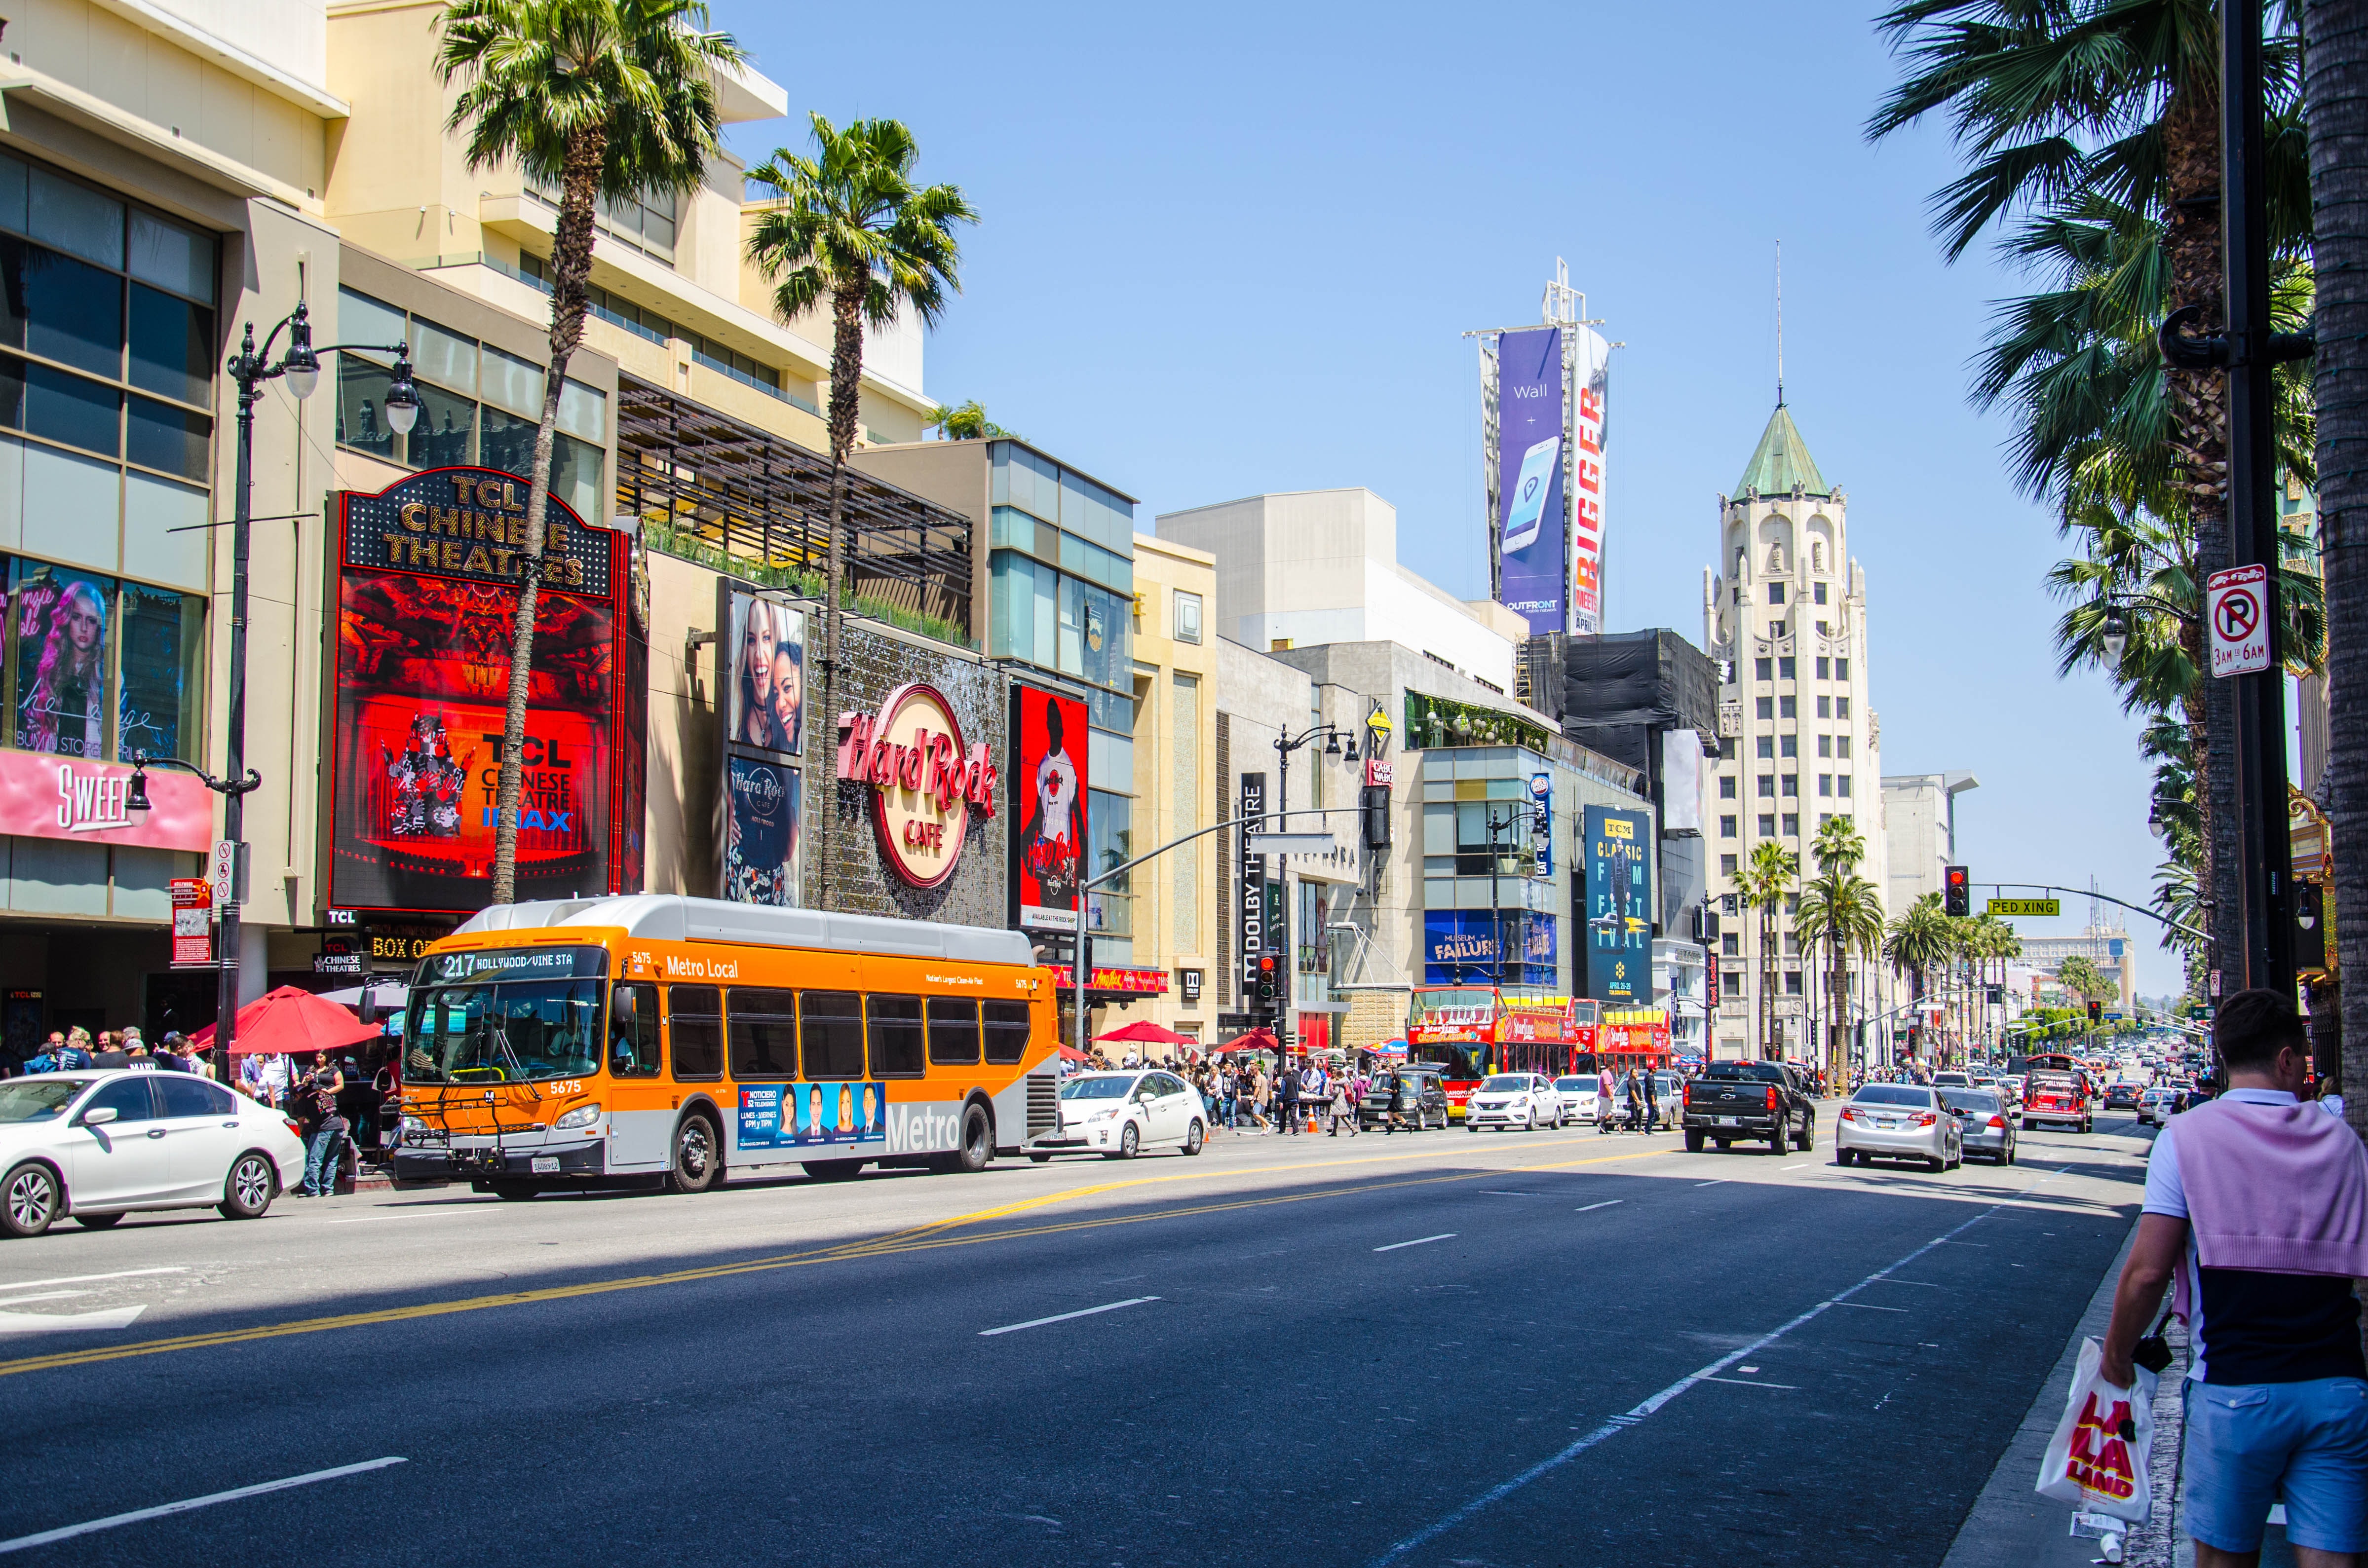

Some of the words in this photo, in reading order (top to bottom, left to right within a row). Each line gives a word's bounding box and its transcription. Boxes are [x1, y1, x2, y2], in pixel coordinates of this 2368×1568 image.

[1513, 383, 1548, 399] Wall
[450, 475, 523, 512] TCL
[1576, 387, 1601, 592] BIGGER
[400, 502, 569, 552] CHINEE
[383, 533, 584, 586] THEATES
[1507, 600, 1558, 610] OUTFRONT
[1576, 590, 1597, 613] MEETS
[1576, 617, 1593, 633] APRIL
[2215, 648, 2232, 667] 3AM
[2243, 643, 2264, 660] 6AM
[482, 734, 572, 768] TCL
[837, 711, 928, 791] Hard
[924, 732, 997, 820] Rock
[1373, 762, 1393, 774] CABO
[482, 768, 571, 791] CNESE
[736, 772, 764, 794] Hard
[1373, 772, 1393, 783] WABO
[58, 764, 131, 828] SWEET
[482, 787, 570, 810] TATRE
[1535, 800, 1545, 817] LAY
[904, 819, 943, 850] CAFE
[1607, 824, 1631, 834] TCM
[1598, 842, 1642, 861] CLASIC
[1537, 861, 1547, 874] EAT
[1598, 862, 1642, 885] FM
[329, 911, 355, 923] TCL
[1245, 885, 1260, 950] DOLBY
[1993, 902, 2018, 913] PED
[2024, 902, 2054, 913] XING
[373, 937, 407, 958] BOX
[1598, 927, 1642, 948] IVAL
[325, 955, 360, 965] CHINESE
[633, 951, 651, 964] 5675
[1435, 938, 1500, 960] FAILURE
[325, 964, 361, 972] THEATRES
[445, 954, 475, 977] 217
[477, 955, 553, 970] HOLLYWOOD/VINE
[556, 954, 573, 965] STA
[667, 956, 705, 977] Metro
[707, 958, 738, 978] Local
[1709, 955, 1717, 984] Locker
[943, 975, 956, 985] Largest
[1015, 979, 1027, 989] 5675
[1609, 981, 1620, 990] APRIL
[550, 1080, 582, 1094] 5675
[750, 1090, 776, 1099] NOTICIERO
[745, 1120, 756, 1128] 6PM
[885, 1104, 960, 1152] Metro
[2077, 1390, 2134, 1437] LA
[2069, 1427, 2135, 1483] LA
[2065, 1459, 2135, 1500] LAND
